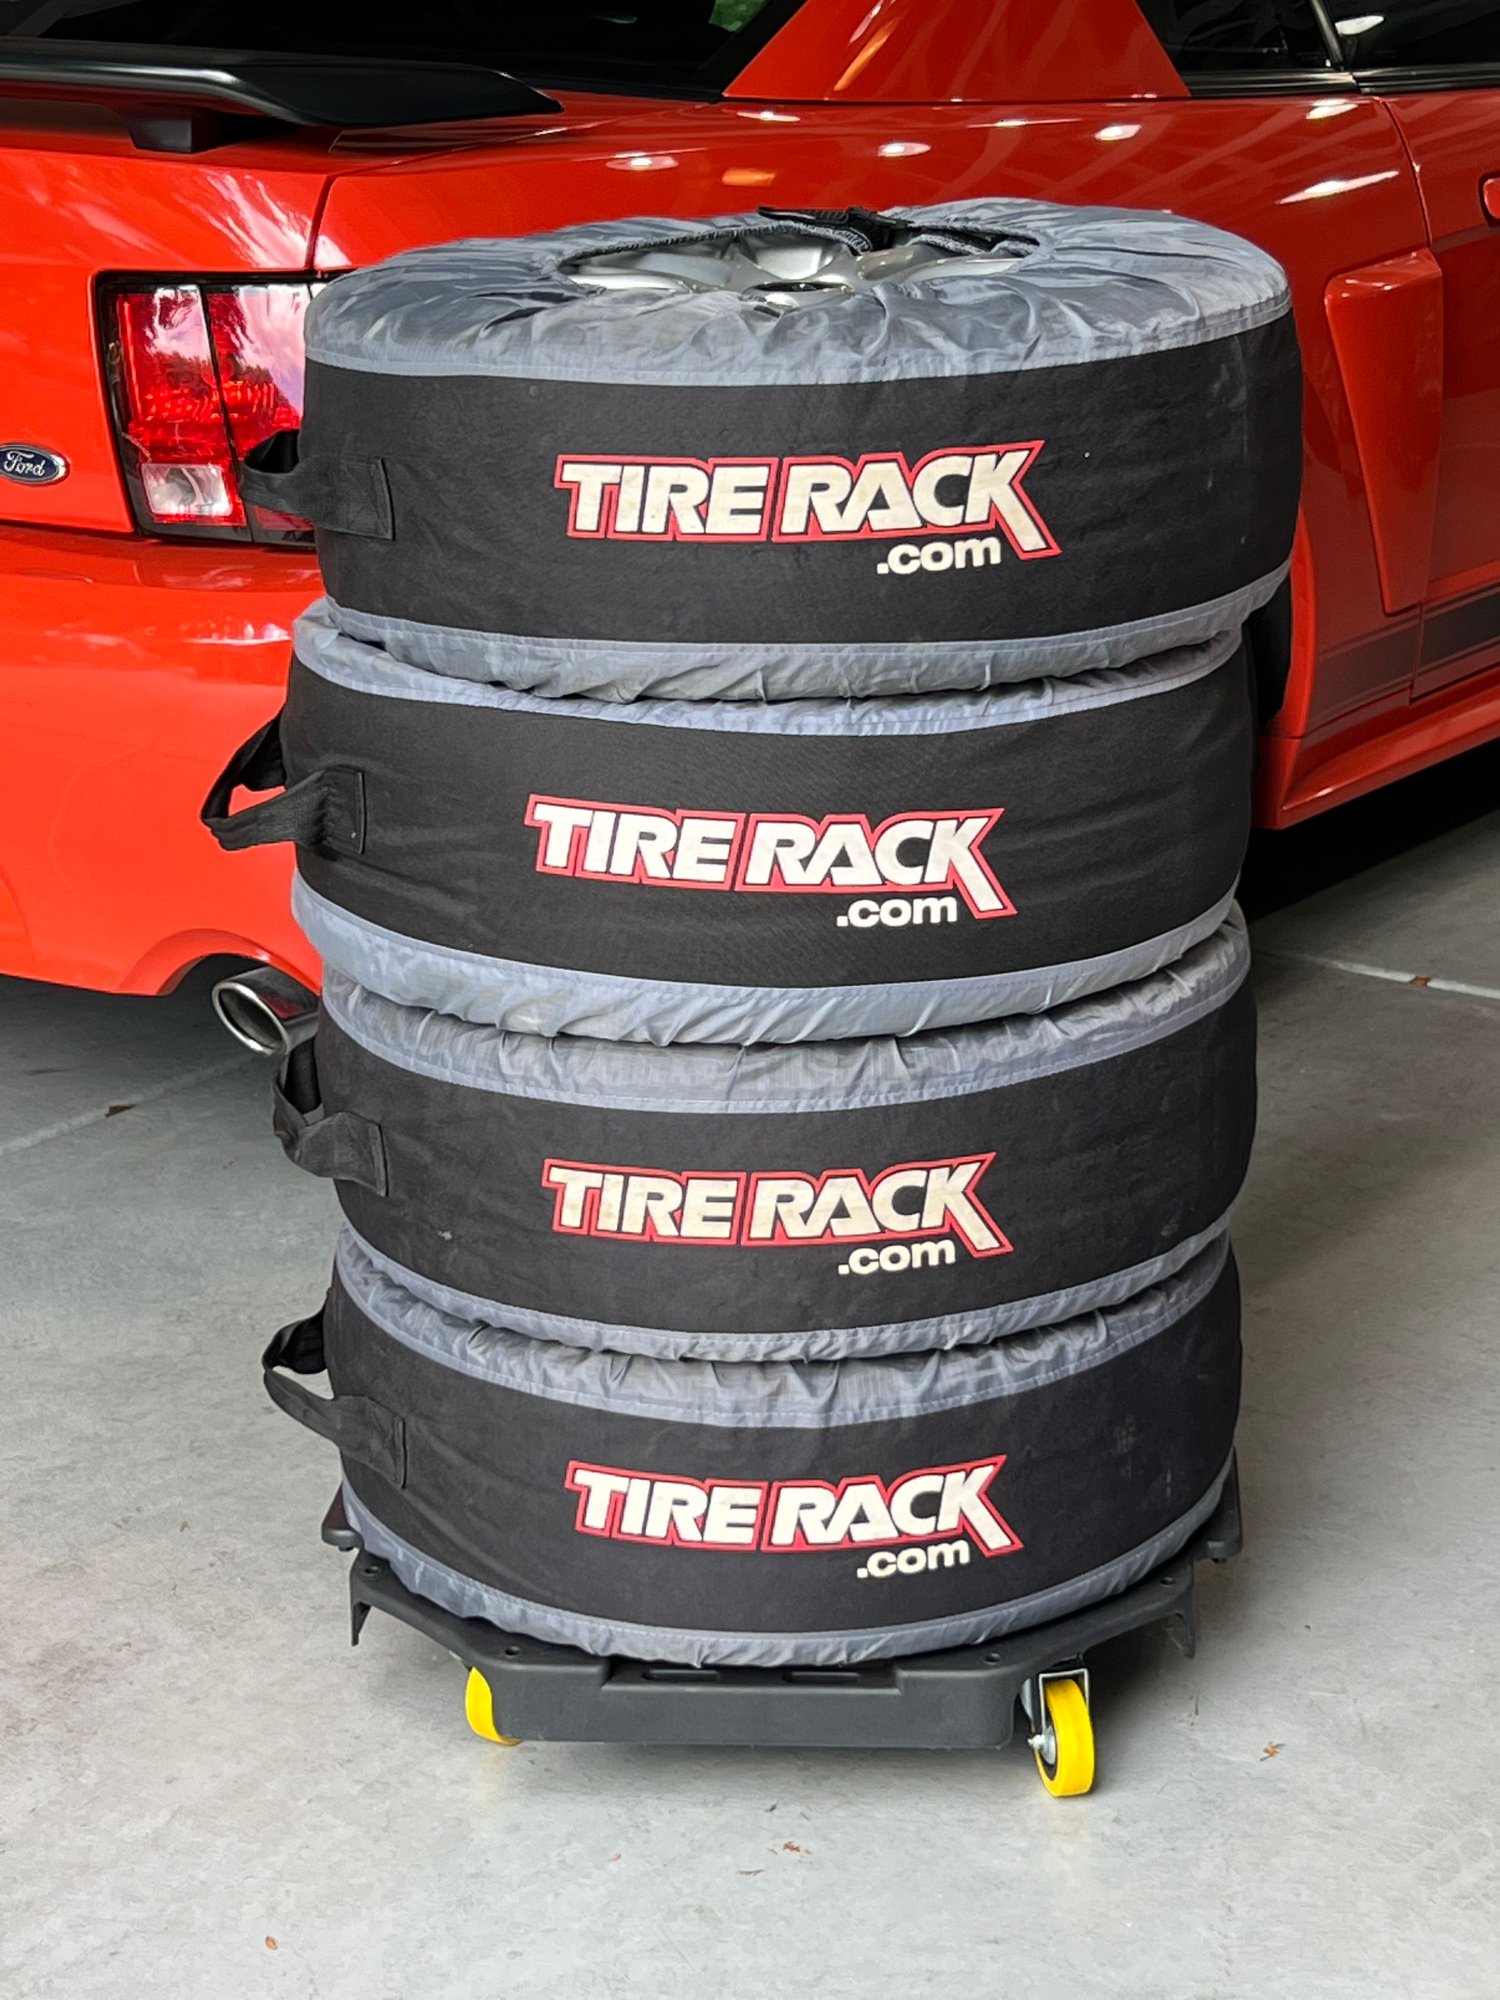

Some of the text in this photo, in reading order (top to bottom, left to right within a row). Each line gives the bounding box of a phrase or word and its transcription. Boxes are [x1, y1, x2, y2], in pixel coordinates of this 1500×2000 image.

[4, 450, 46, 477] Ford
[876, 535, 1001, 575] .com
[836, 896, 958, 929] .com
[837, 1238, 956, 1276] .com
[856, 1538, 971, 1580] .com
